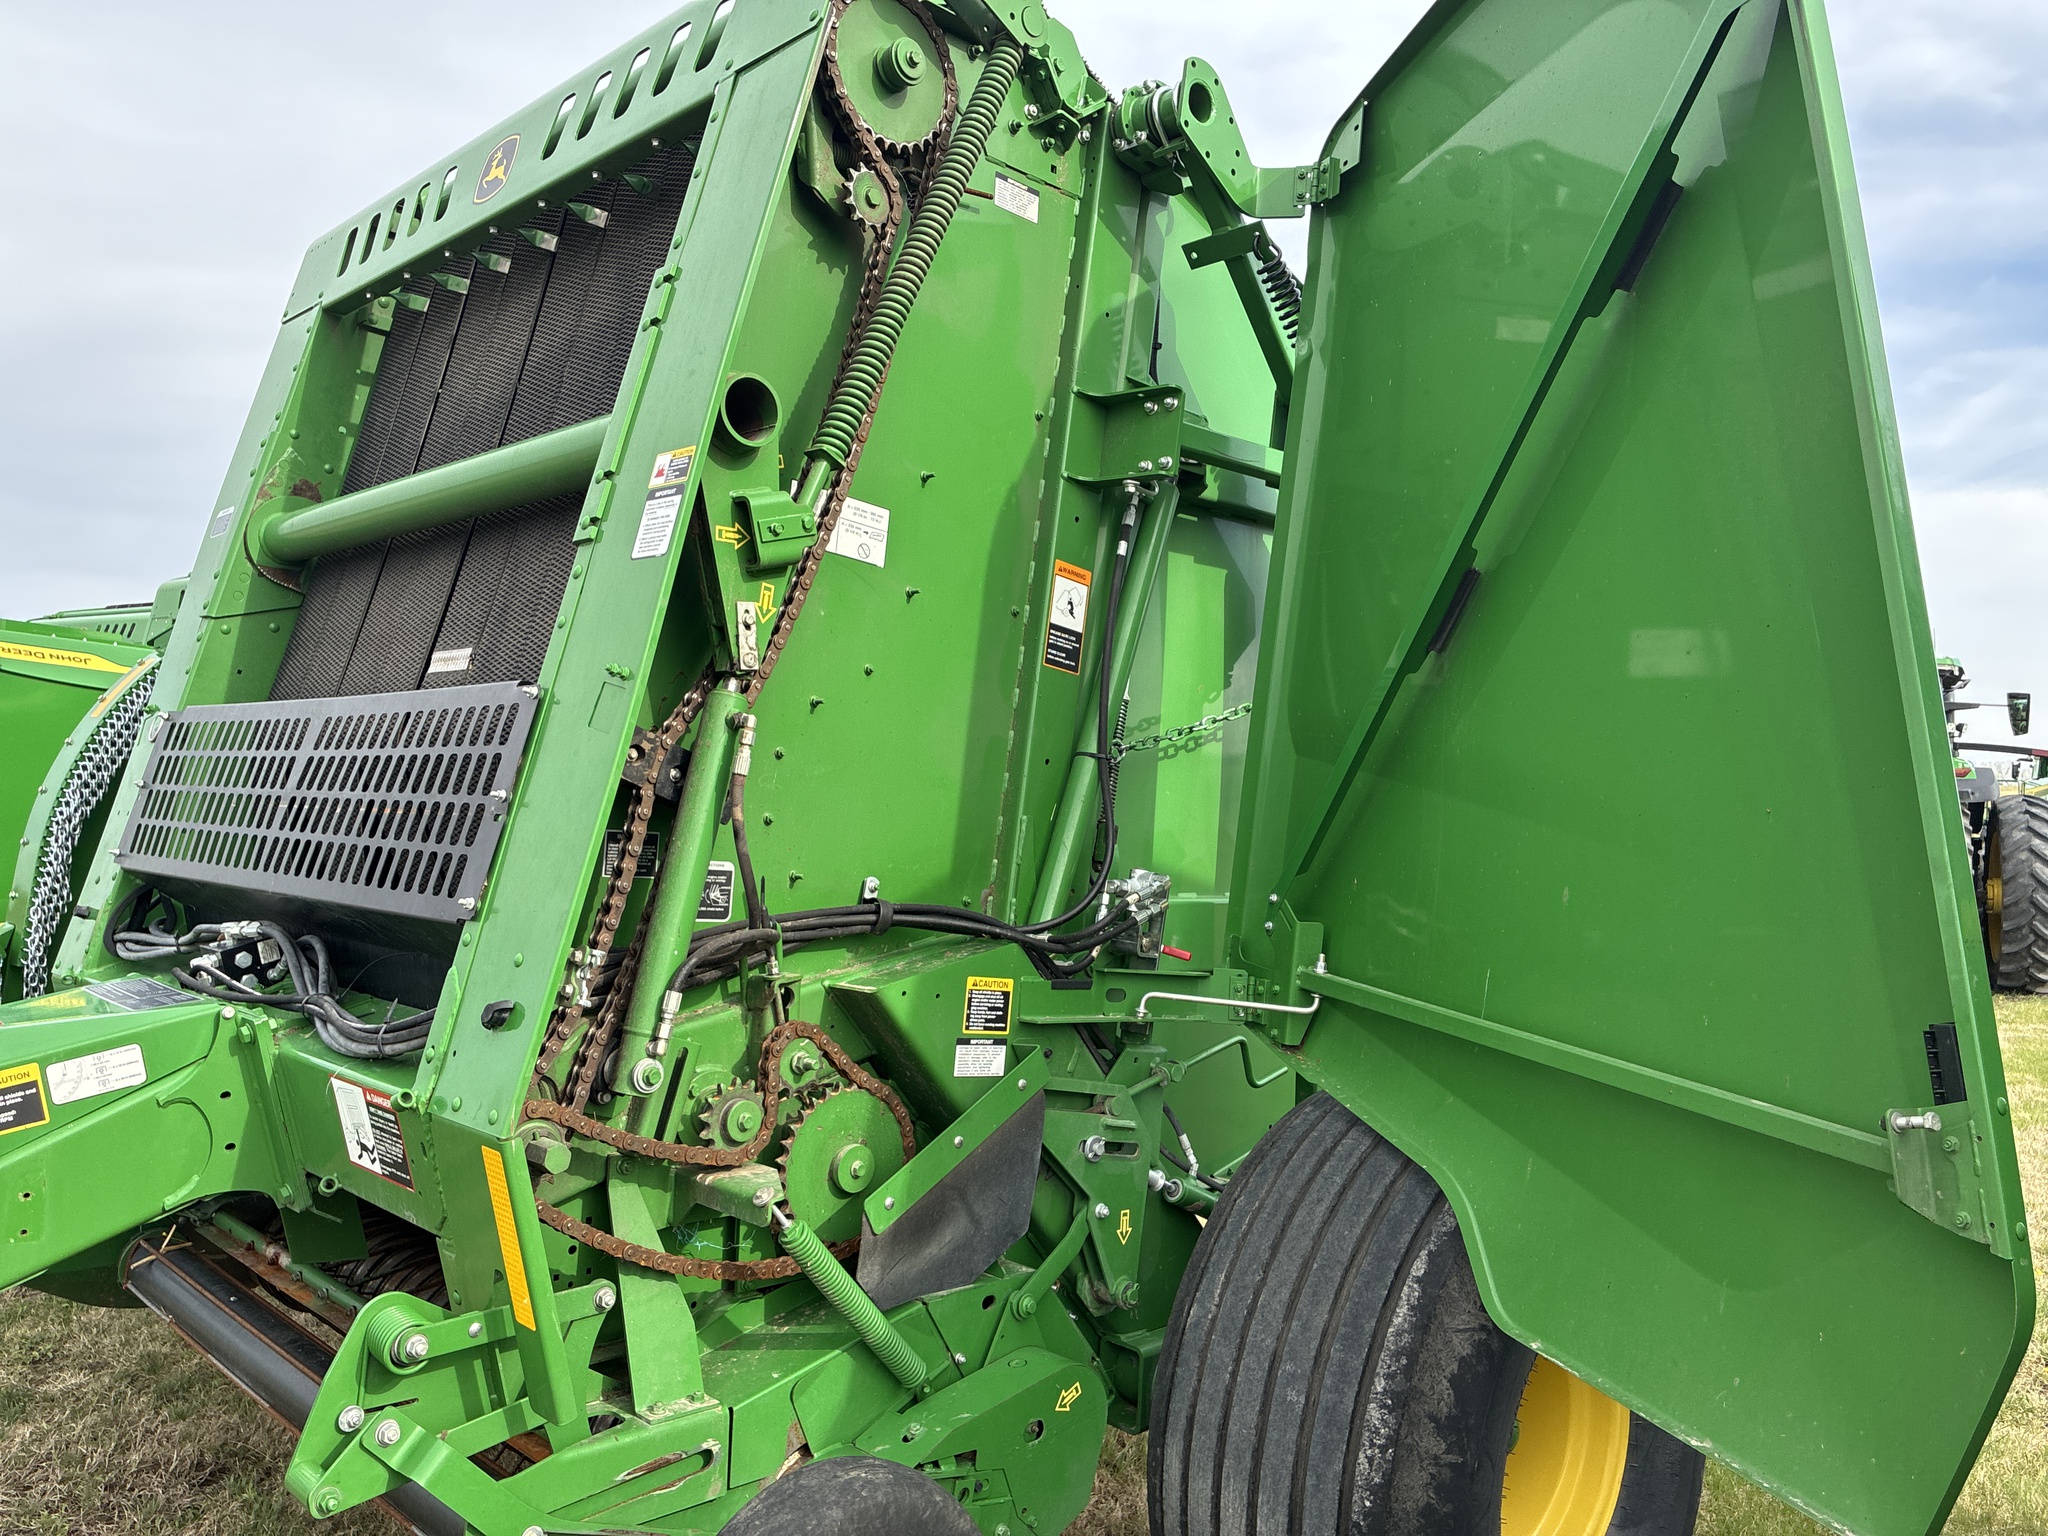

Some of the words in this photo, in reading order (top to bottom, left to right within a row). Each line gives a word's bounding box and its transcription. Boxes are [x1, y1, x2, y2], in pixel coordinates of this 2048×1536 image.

[1062, 566, 1087, 580] WARNING
[49, 653, 91, 665] JOHN
[978, 980, 1009, 988] CAUTION
